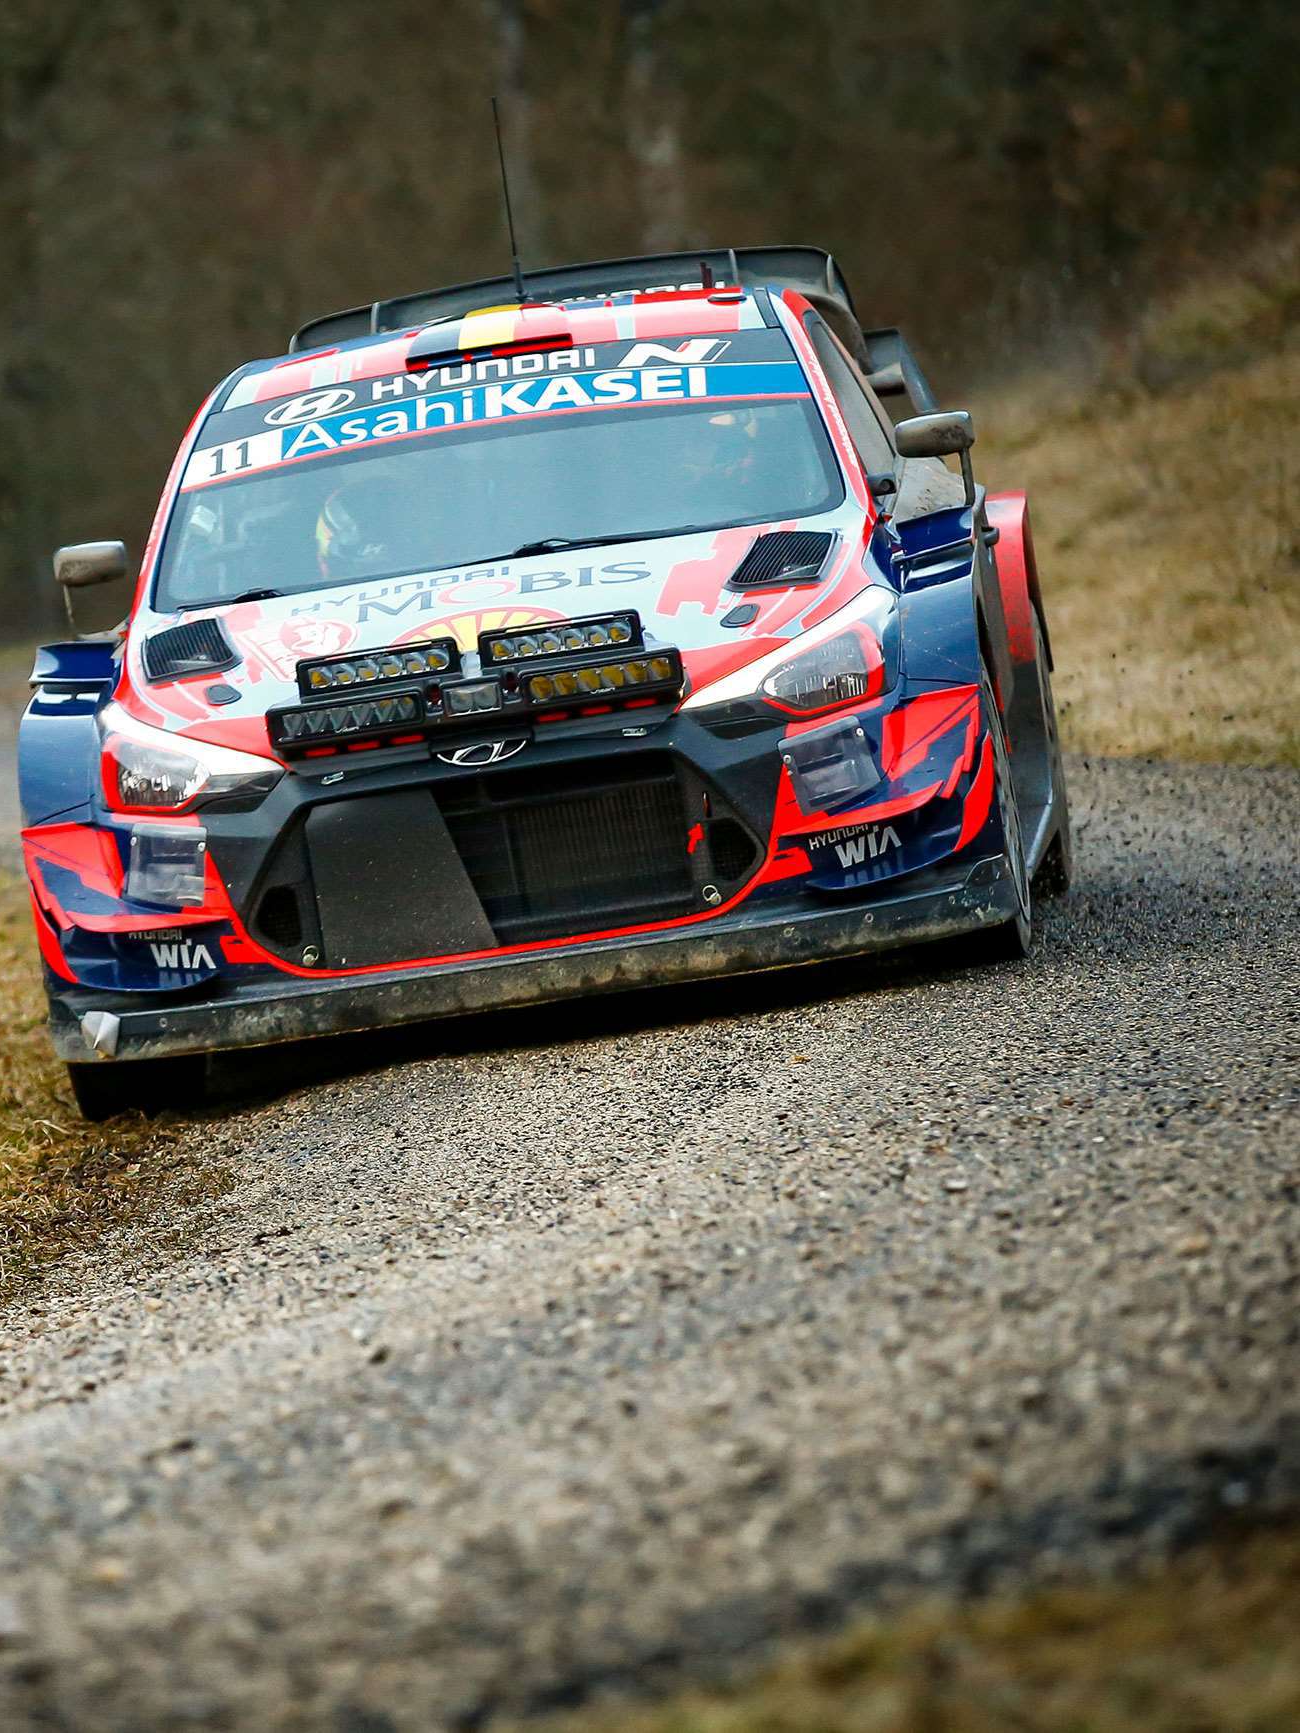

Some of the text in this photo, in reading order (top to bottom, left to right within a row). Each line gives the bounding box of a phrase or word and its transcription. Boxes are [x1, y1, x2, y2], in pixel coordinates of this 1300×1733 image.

[371, 347, 596, 400] HYUNDAI
[209, 441, 252, 477] 11
[291, 566, 509, 617] HYUNDAI
[356, 561, 651, 623] MOBIS
[834, 825, 902, 868] WIA
[150, 938, 217, 969] WIA
